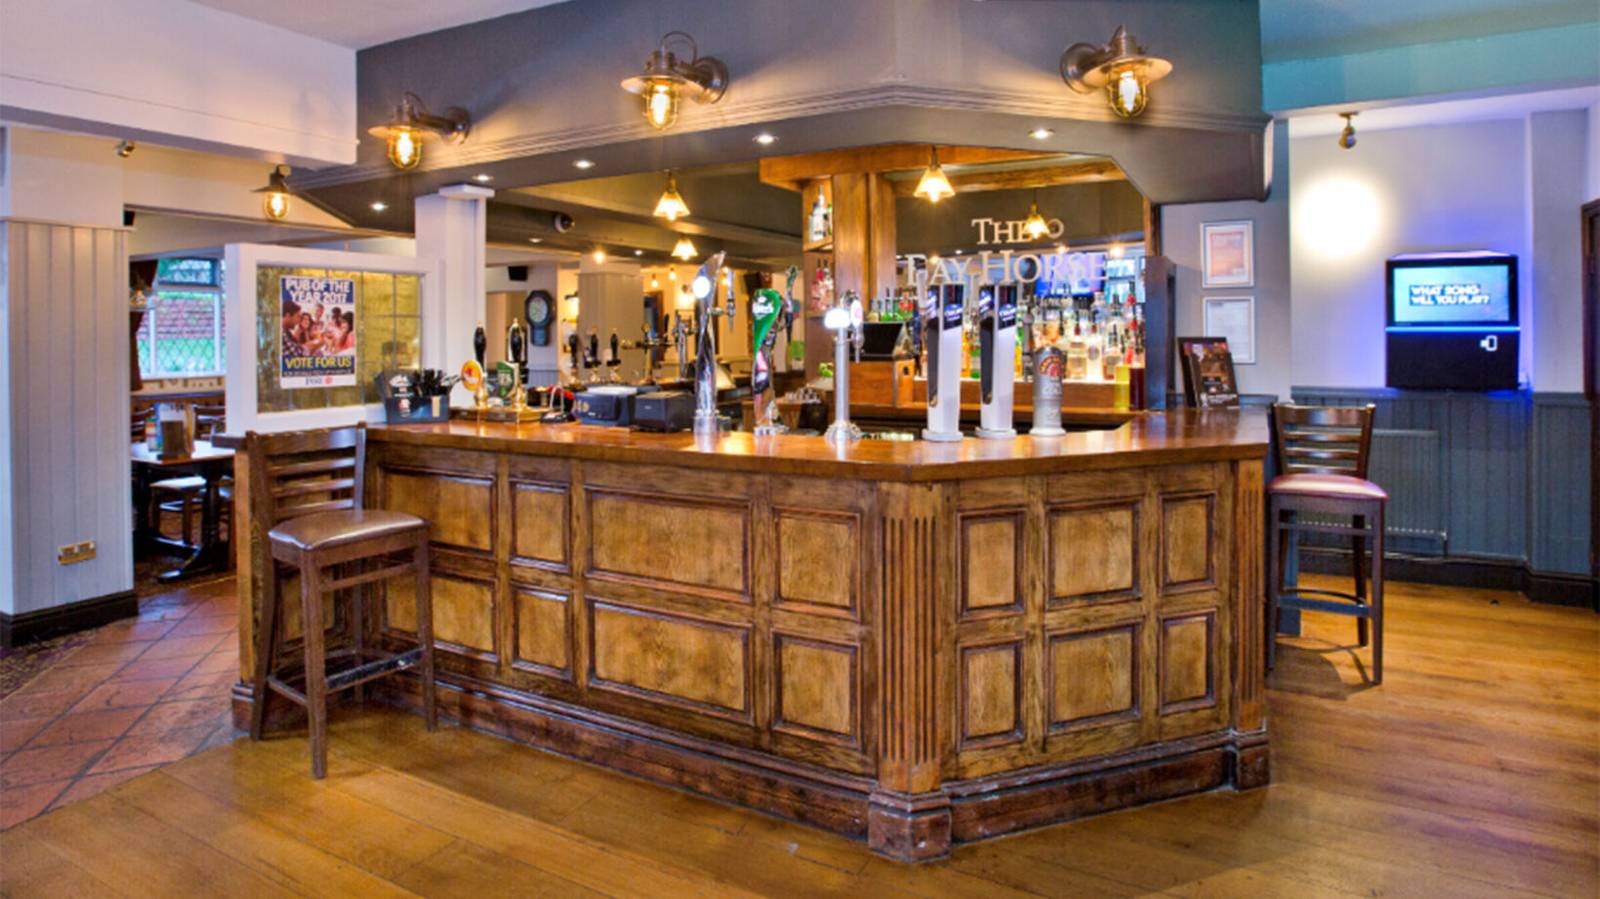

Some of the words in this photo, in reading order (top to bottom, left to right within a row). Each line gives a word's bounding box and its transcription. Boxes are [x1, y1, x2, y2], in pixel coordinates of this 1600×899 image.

[971, 218, 1034, 245] THE
[978, 249, 1110, 285] HORSE
[285, 278, 311, 291] PUB
[311, 279, 328, 291] OF
[329, 280, 350, 293] THE
[1411, 286, 1443, 295] WHAT
[1444, 285, 1480, 295] SONG
[290, 291, 321, 304] YEAR
[1411, 296, 1436, 305] WILL
[1436, 296, 1458, 305] YOU
[285, 356, 313, 369] VOTE
[315, 356, 336, 368] FOR
[338, 355, 352, 368] US
